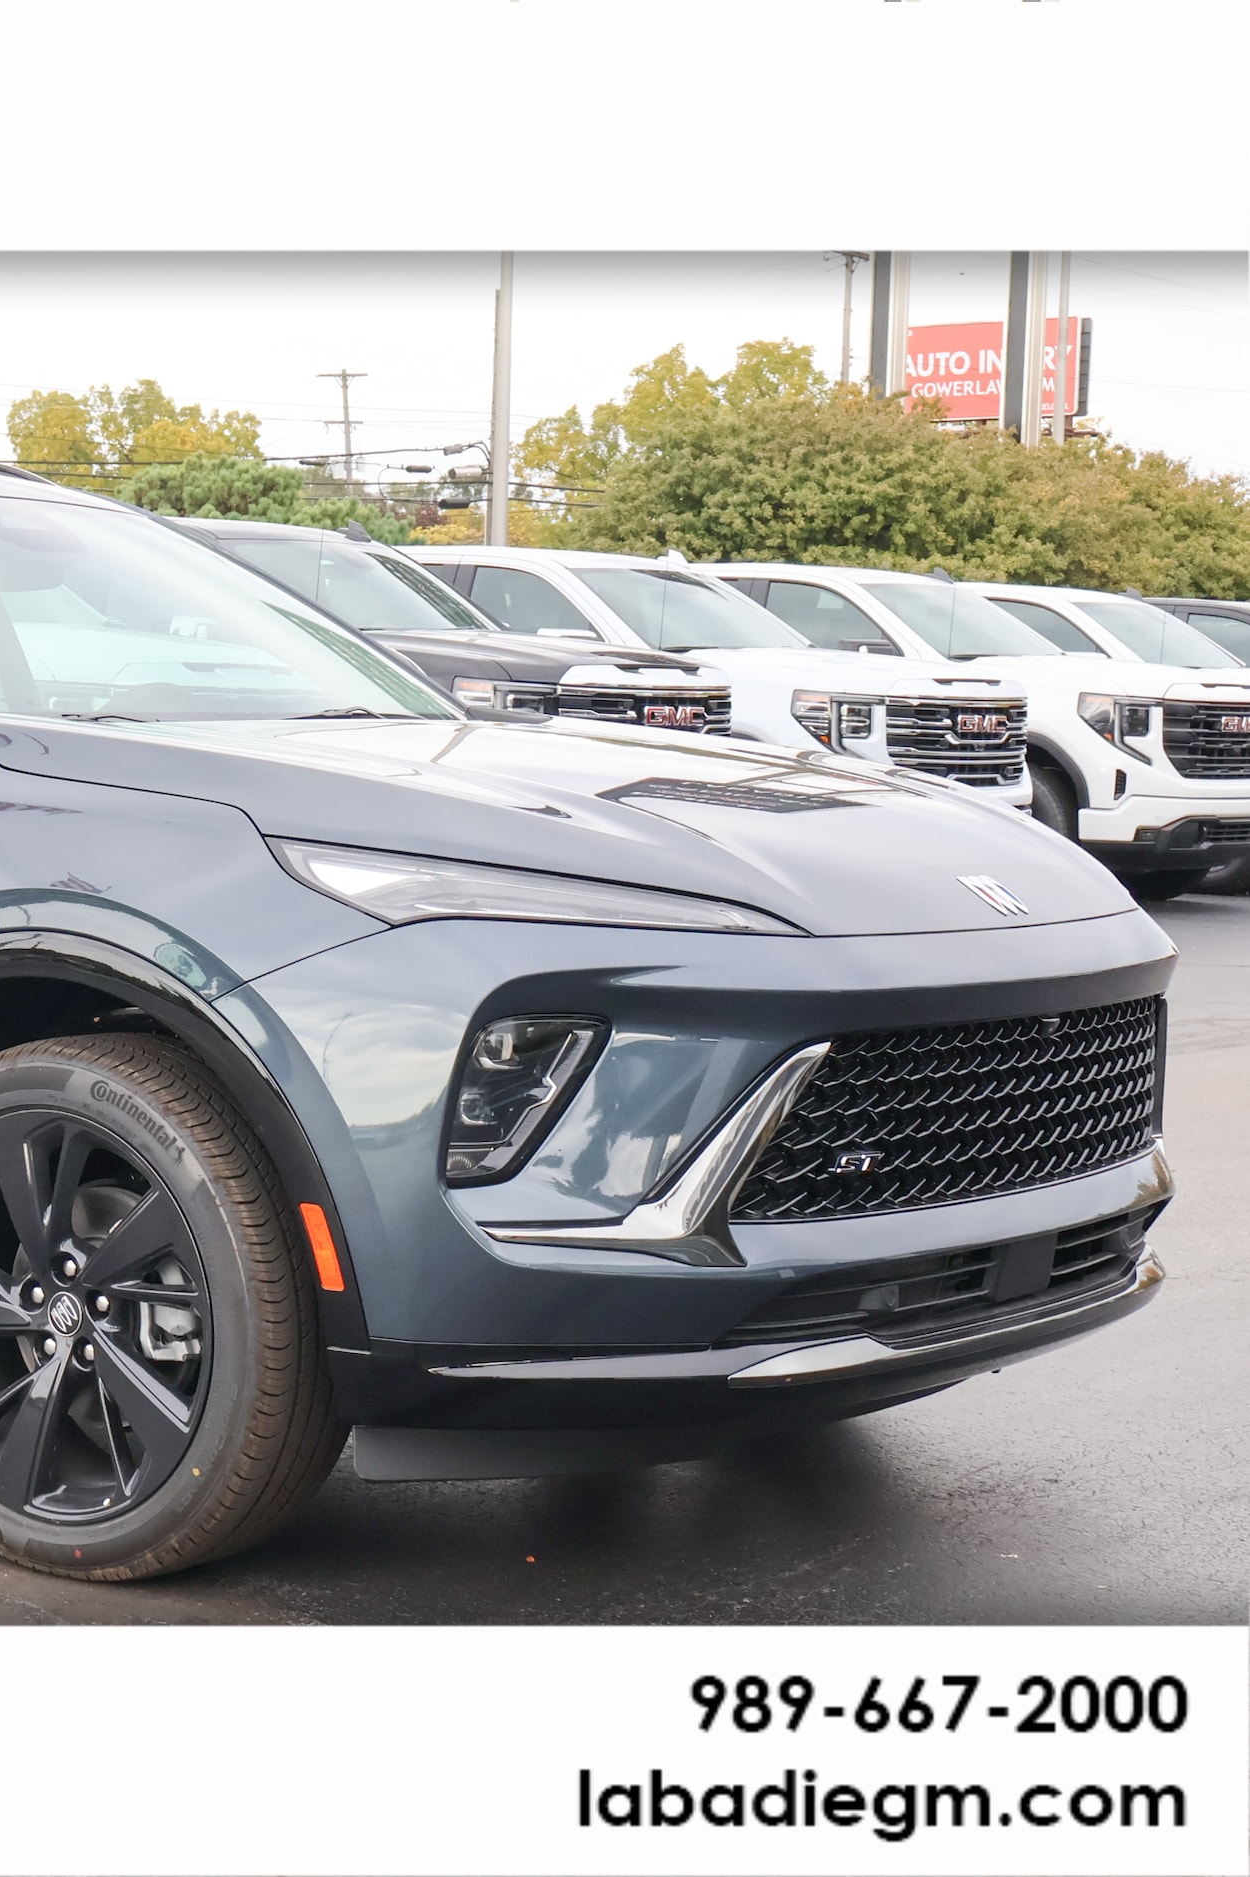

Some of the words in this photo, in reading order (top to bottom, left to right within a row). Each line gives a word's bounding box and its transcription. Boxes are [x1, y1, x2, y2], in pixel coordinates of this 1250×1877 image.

[906, 350, 971, 377] AUTO
[644, 705, 705, 726] GMC
[957, 714, 1007, 733] GMC
[1221, 716, 1250, 732] GM
[90, 1080, 178, 1152] Continental
[828, 1150, 885, 1174] ST
